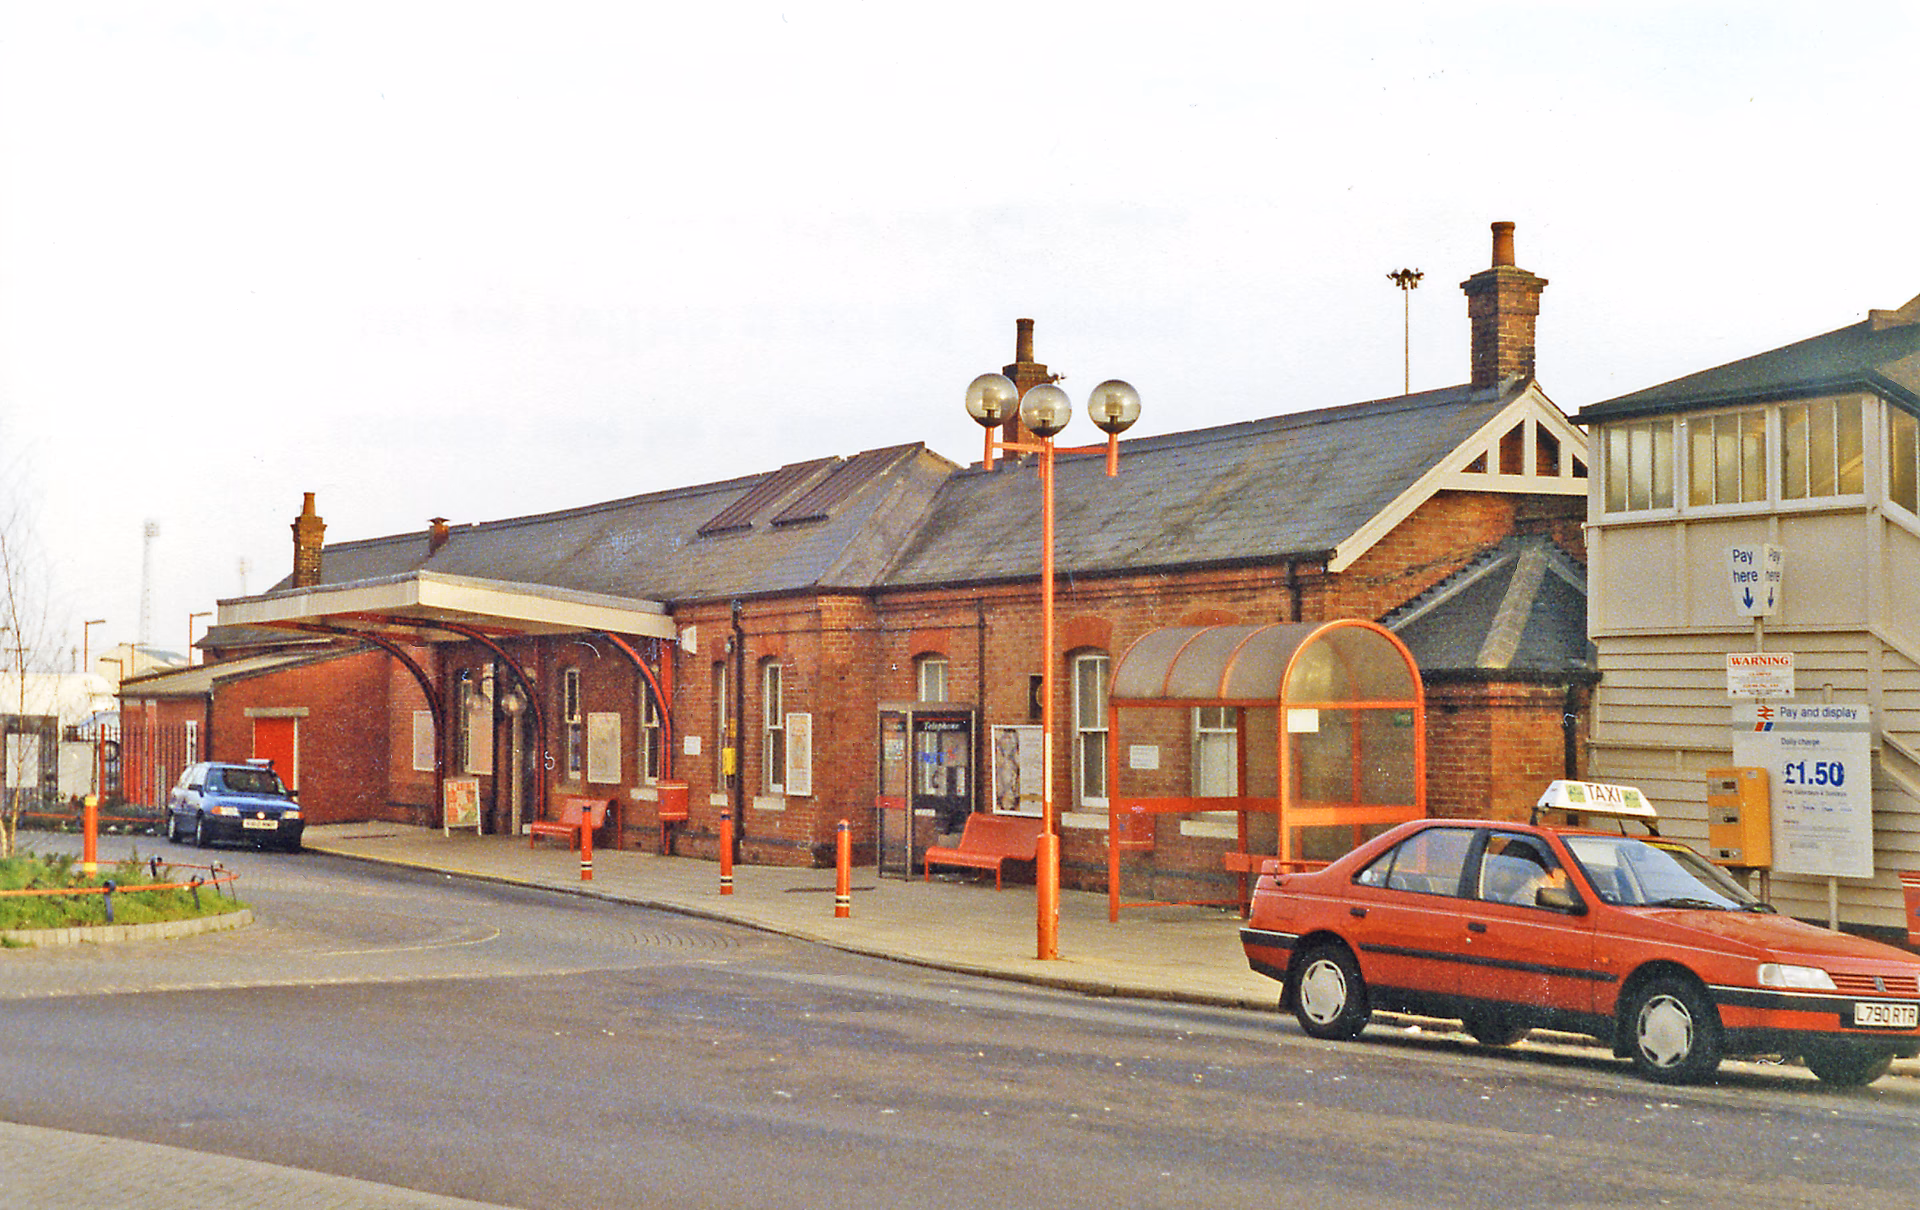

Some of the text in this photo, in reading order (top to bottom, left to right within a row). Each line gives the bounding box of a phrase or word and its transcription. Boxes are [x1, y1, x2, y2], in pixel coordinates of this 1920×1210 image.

[1732, 549, 1753, 565] Pay
[1733, 570, 1758, 583] here
[1731, 656, 1789, 666] WARNING
[1780, 706, 1857, 720] Pay and display
[1785, 761, 1845, 787] £1.50
[1585, 784, 1622, 803] TAXI
[1856, 1005, 1890, 1023] L790
